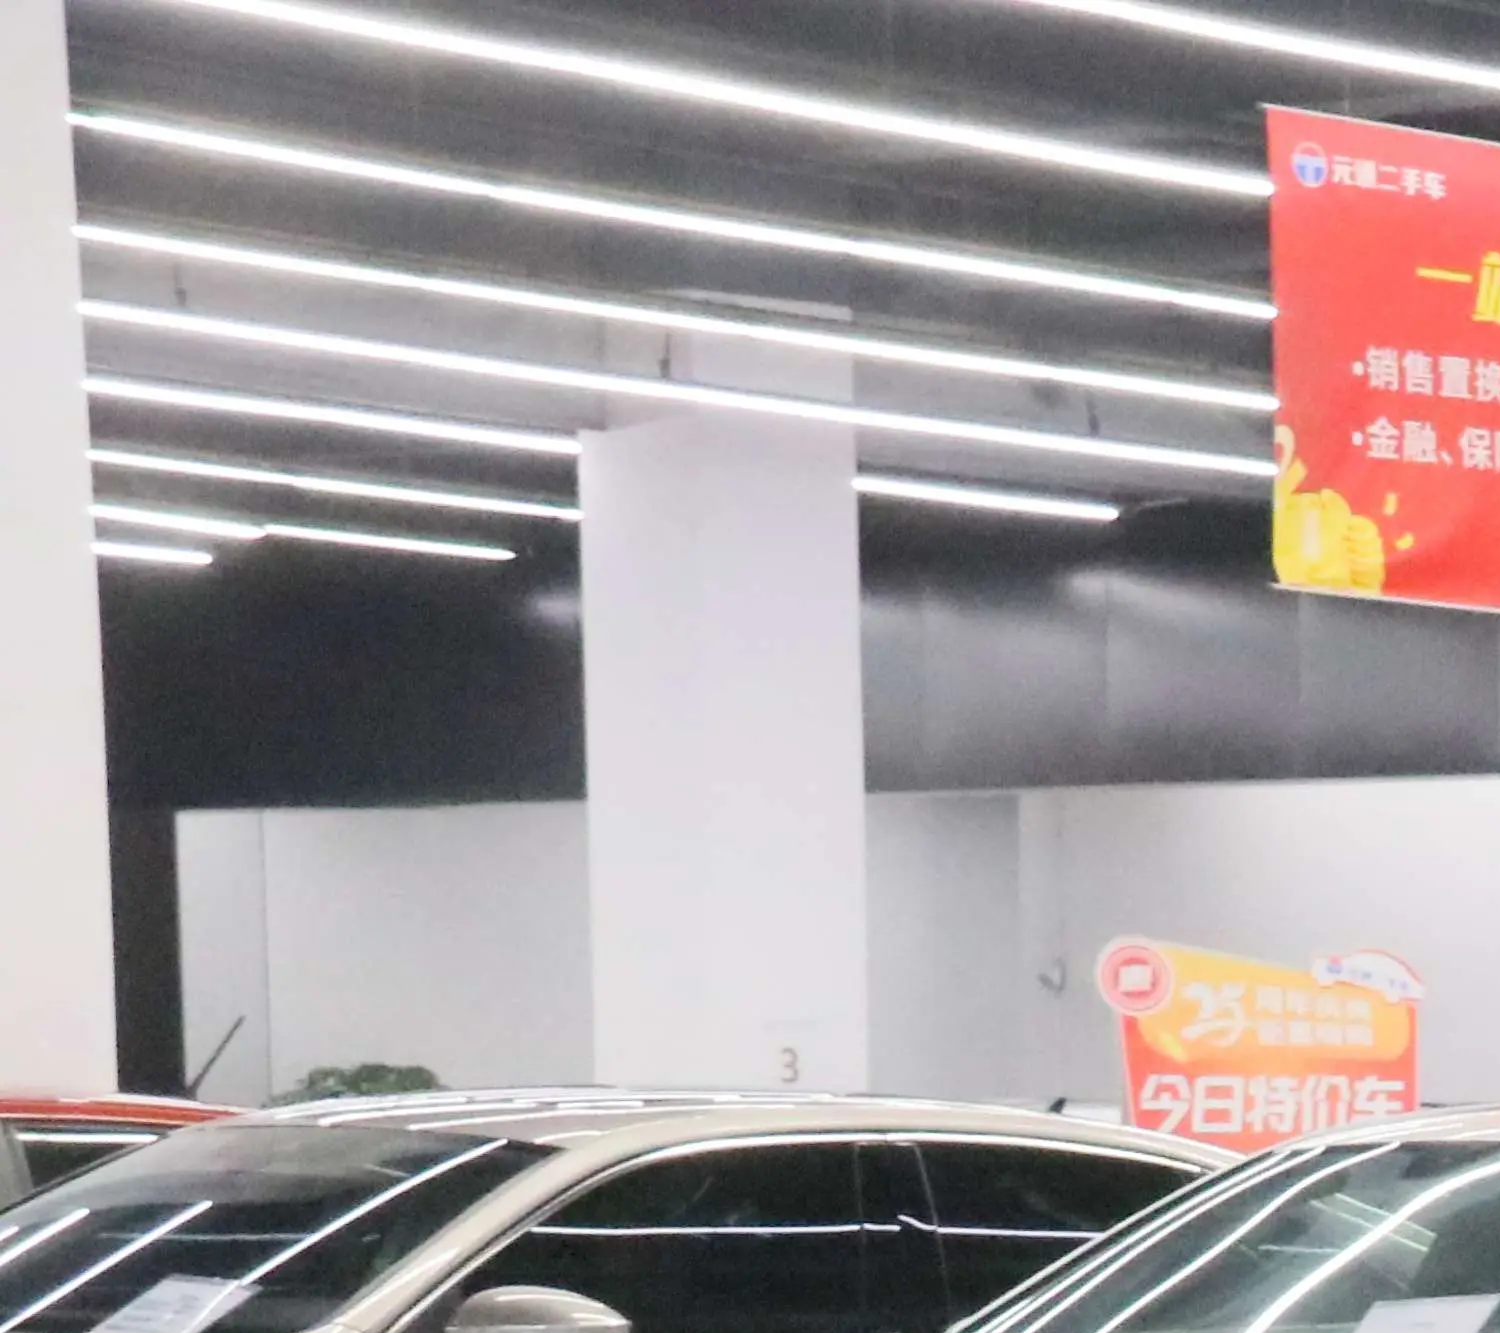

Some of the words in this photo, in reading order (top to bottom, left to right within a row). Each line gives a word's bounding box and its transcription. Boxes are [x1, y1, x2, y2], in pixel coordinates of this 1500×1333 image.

[781, 1047, 799, 1083] 3
[1141, 1074, 1406, 1134] 今日特价车
